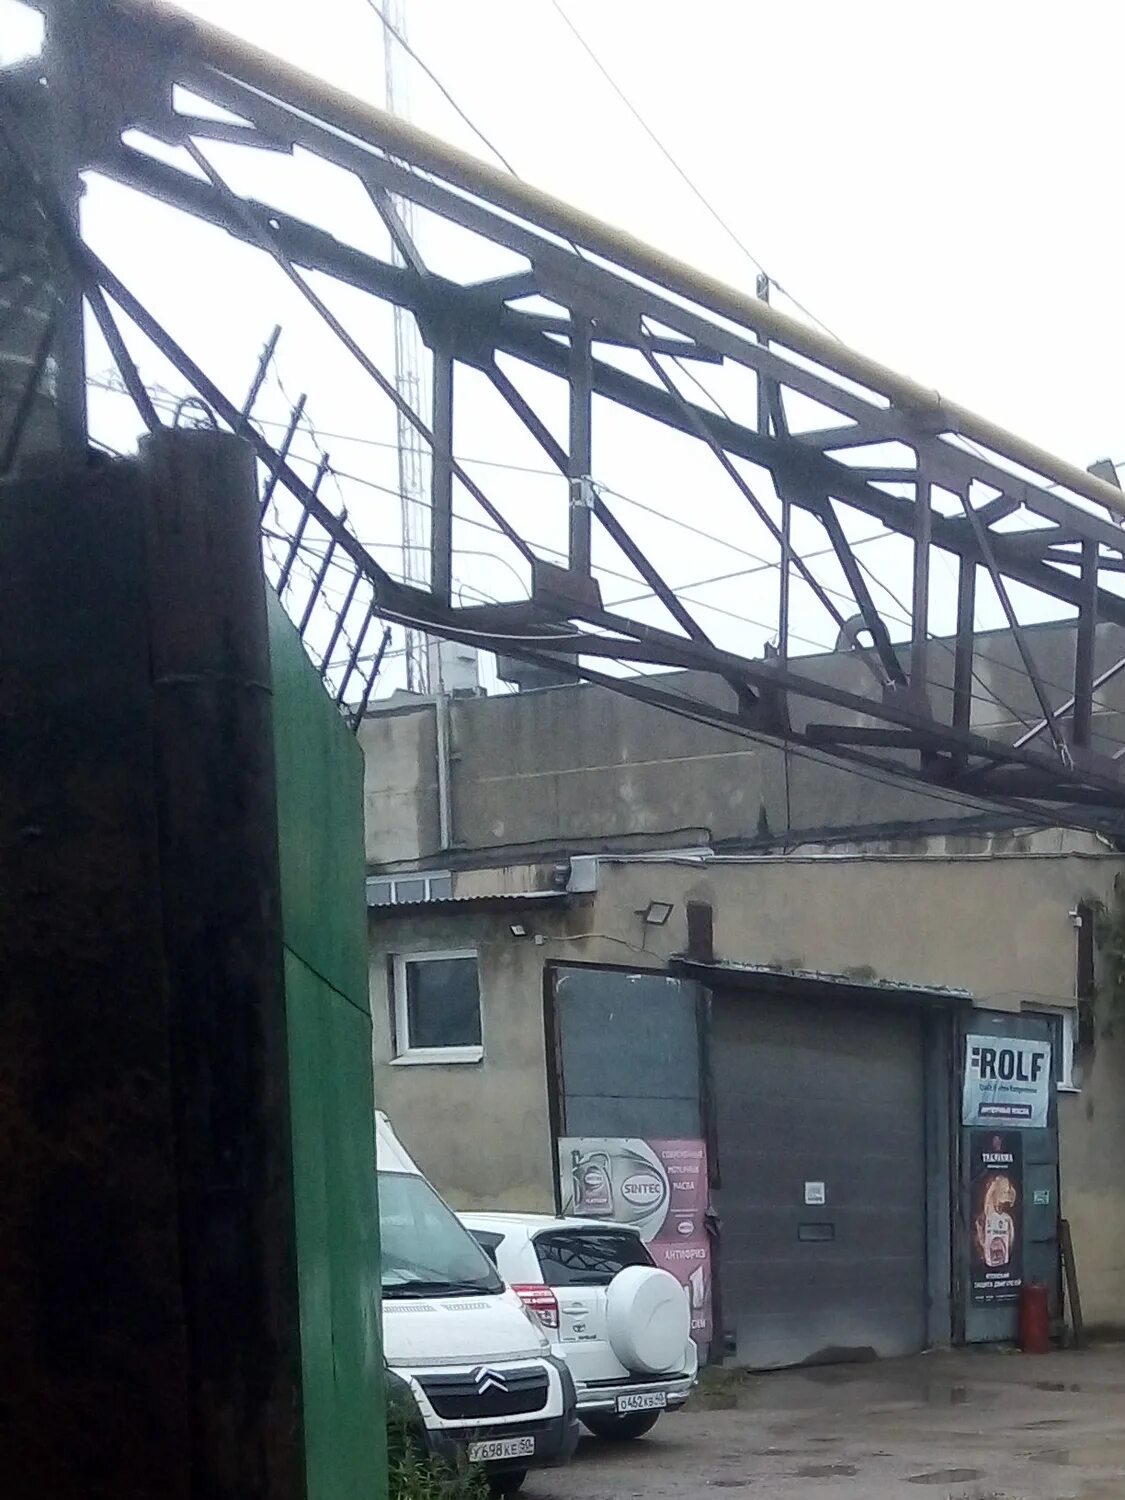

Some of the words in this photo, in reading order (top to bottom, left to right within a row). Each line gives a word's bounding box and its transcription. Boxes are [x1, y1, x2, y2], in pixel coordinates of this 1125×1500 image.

[980, 1047, 1045, 1082] ROLF
[625, 1184, 660, 1194] SINTEC
[665, 1248, 705, 1259] АНТИФРИЗ
